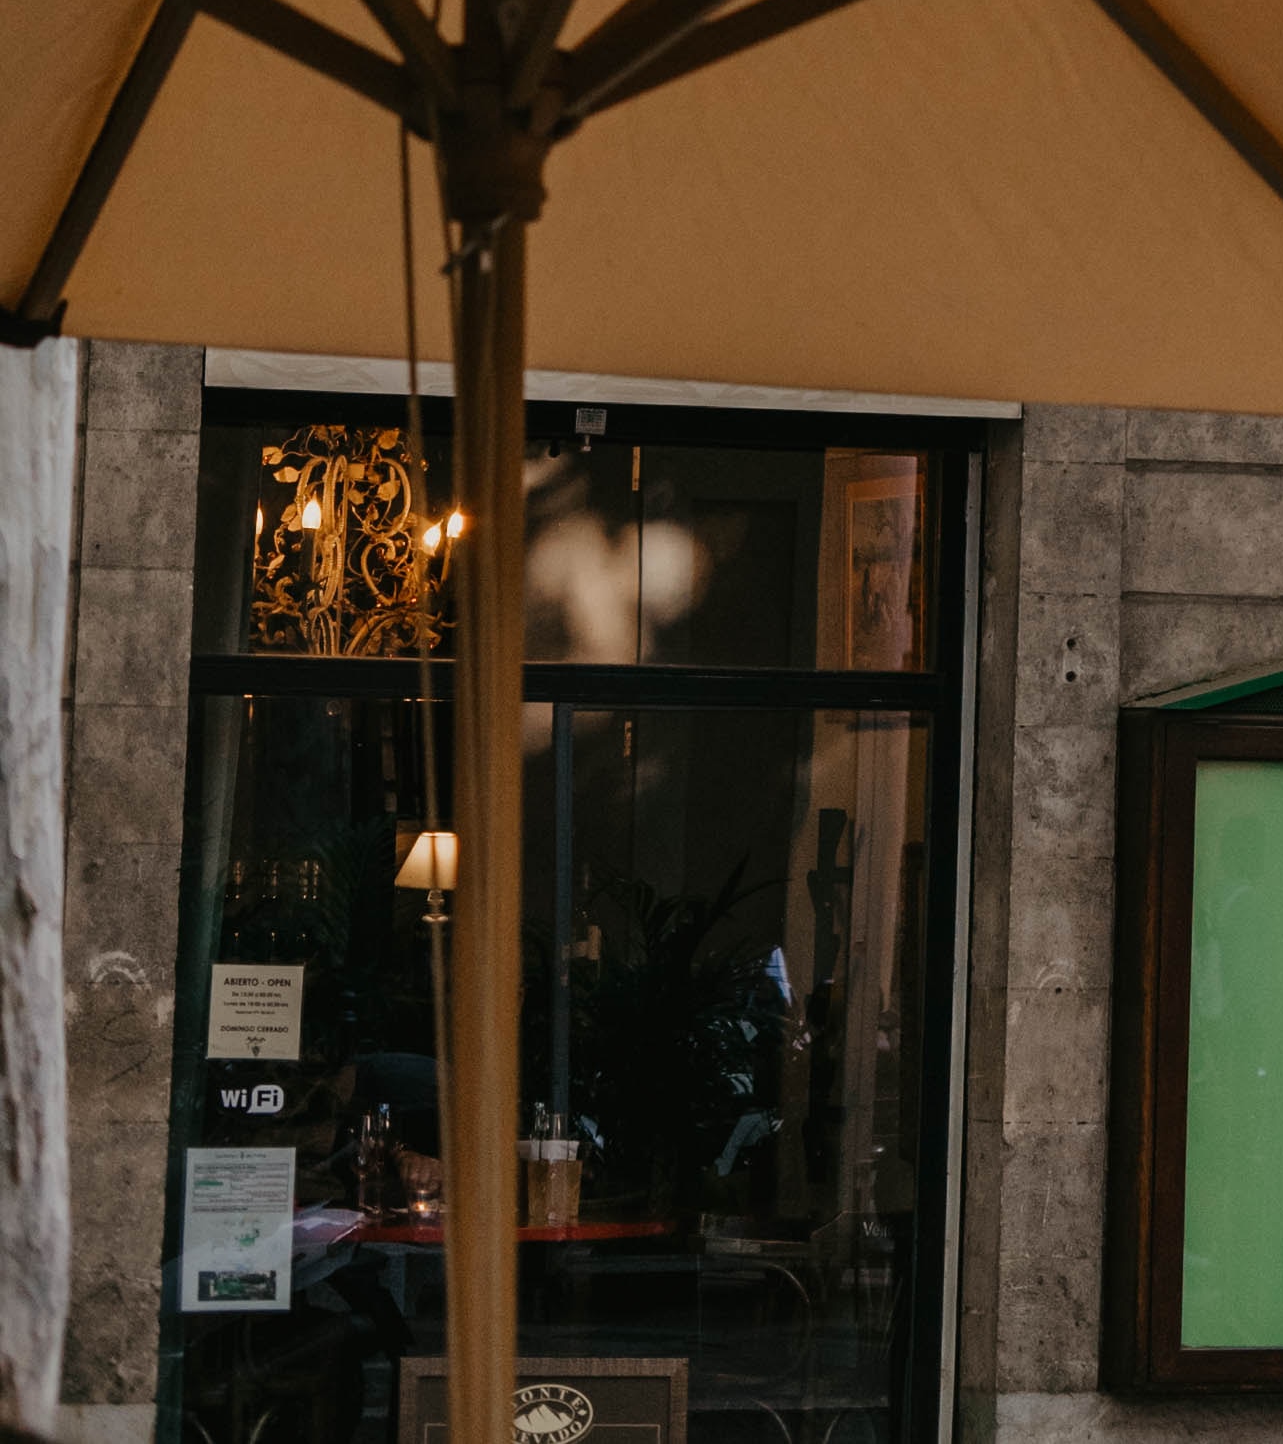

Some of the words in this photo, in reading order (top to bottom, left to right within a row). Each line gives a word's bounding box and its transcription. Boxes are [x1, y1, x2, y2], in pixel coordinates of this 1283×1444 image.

[223, 977, 259, 987] ABIERTO
[267, 978, 291, 987] OPEN
[220, 1024, 255, 1033] DOMINGO
[256, 1025, 288, 1034] CERRADO
[512, 1387, 584, 1411] ONTE
